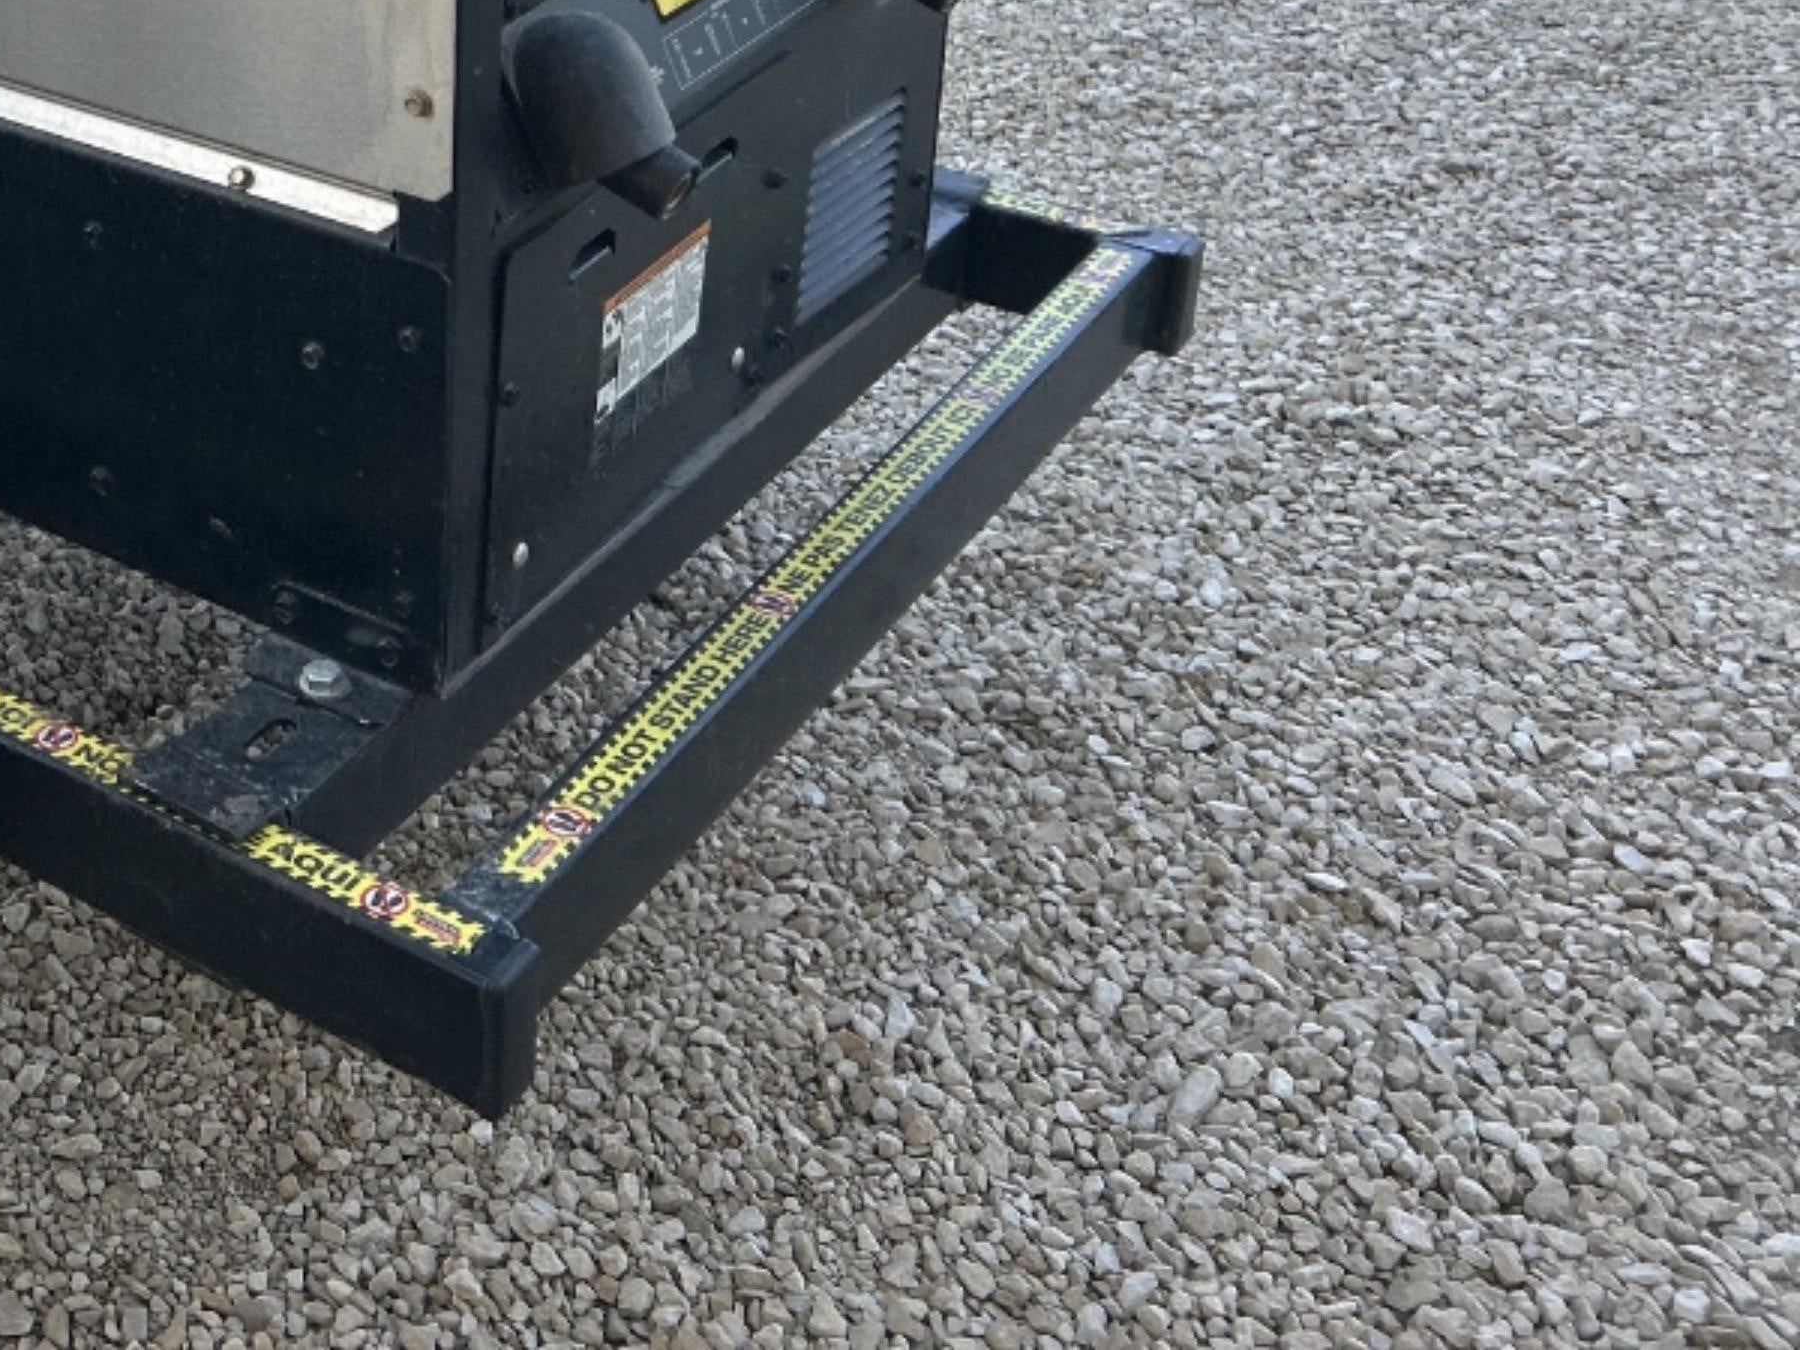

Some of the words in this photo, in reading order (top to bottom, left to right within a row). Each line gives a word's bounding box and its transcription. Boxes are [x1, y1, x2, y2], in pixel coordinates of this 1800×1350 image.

[800, 534, 845, 566] PAS
[575, 776, 616, 810] DO
[605, 728, 659, 774] NOT
[650, 664, 721, 730] STAND
[714, 613, 771, 665] HERE
[267, 841, 363, 891] AQUI
